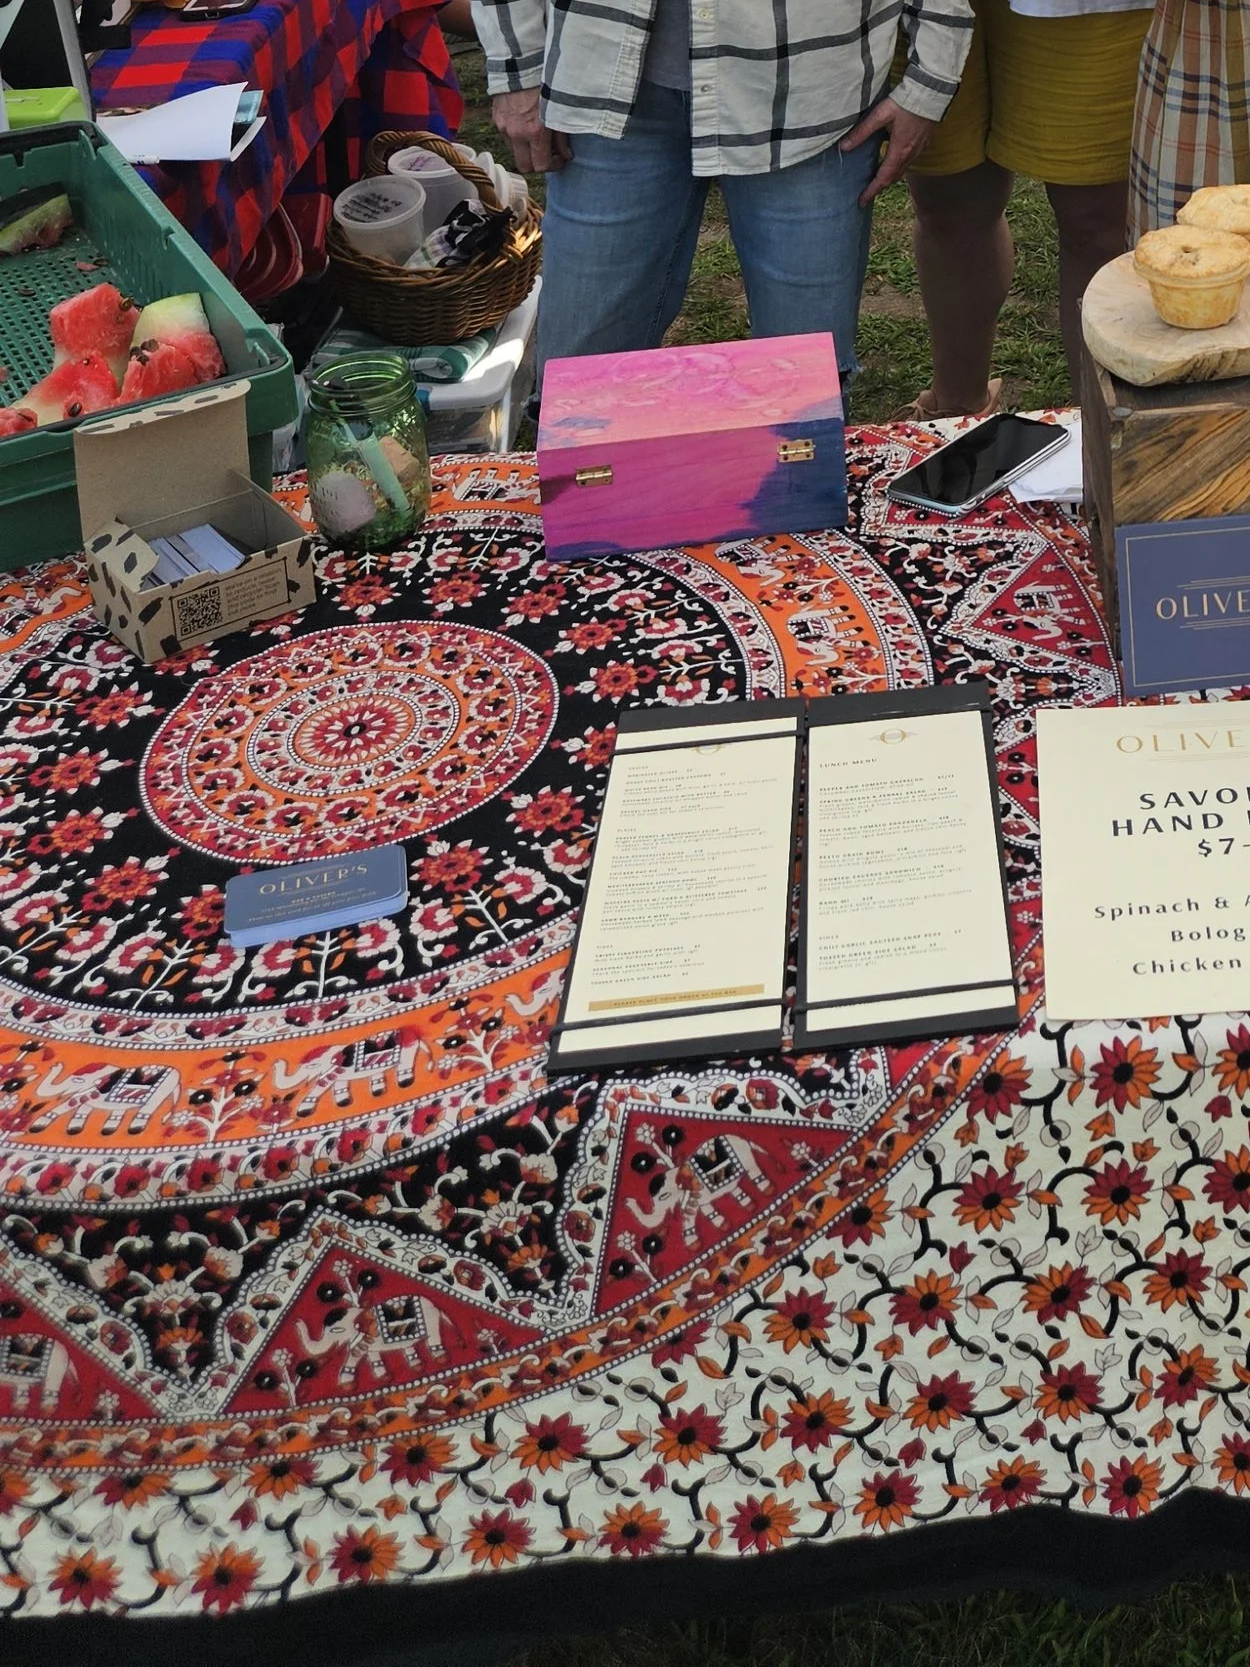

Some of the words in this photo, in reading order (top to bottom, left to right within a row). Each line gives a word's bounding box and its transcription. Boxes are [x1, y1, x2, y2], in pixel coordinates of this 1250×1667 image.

[1112, 812, 1224, 836] HAND
[259, 864, 369, 895] OLIVER'S
[1094, 898, 1200, 921] Spinach
[1214, 897, 1230, 910] &
[1132, 957, 1242, 975] Chicken
